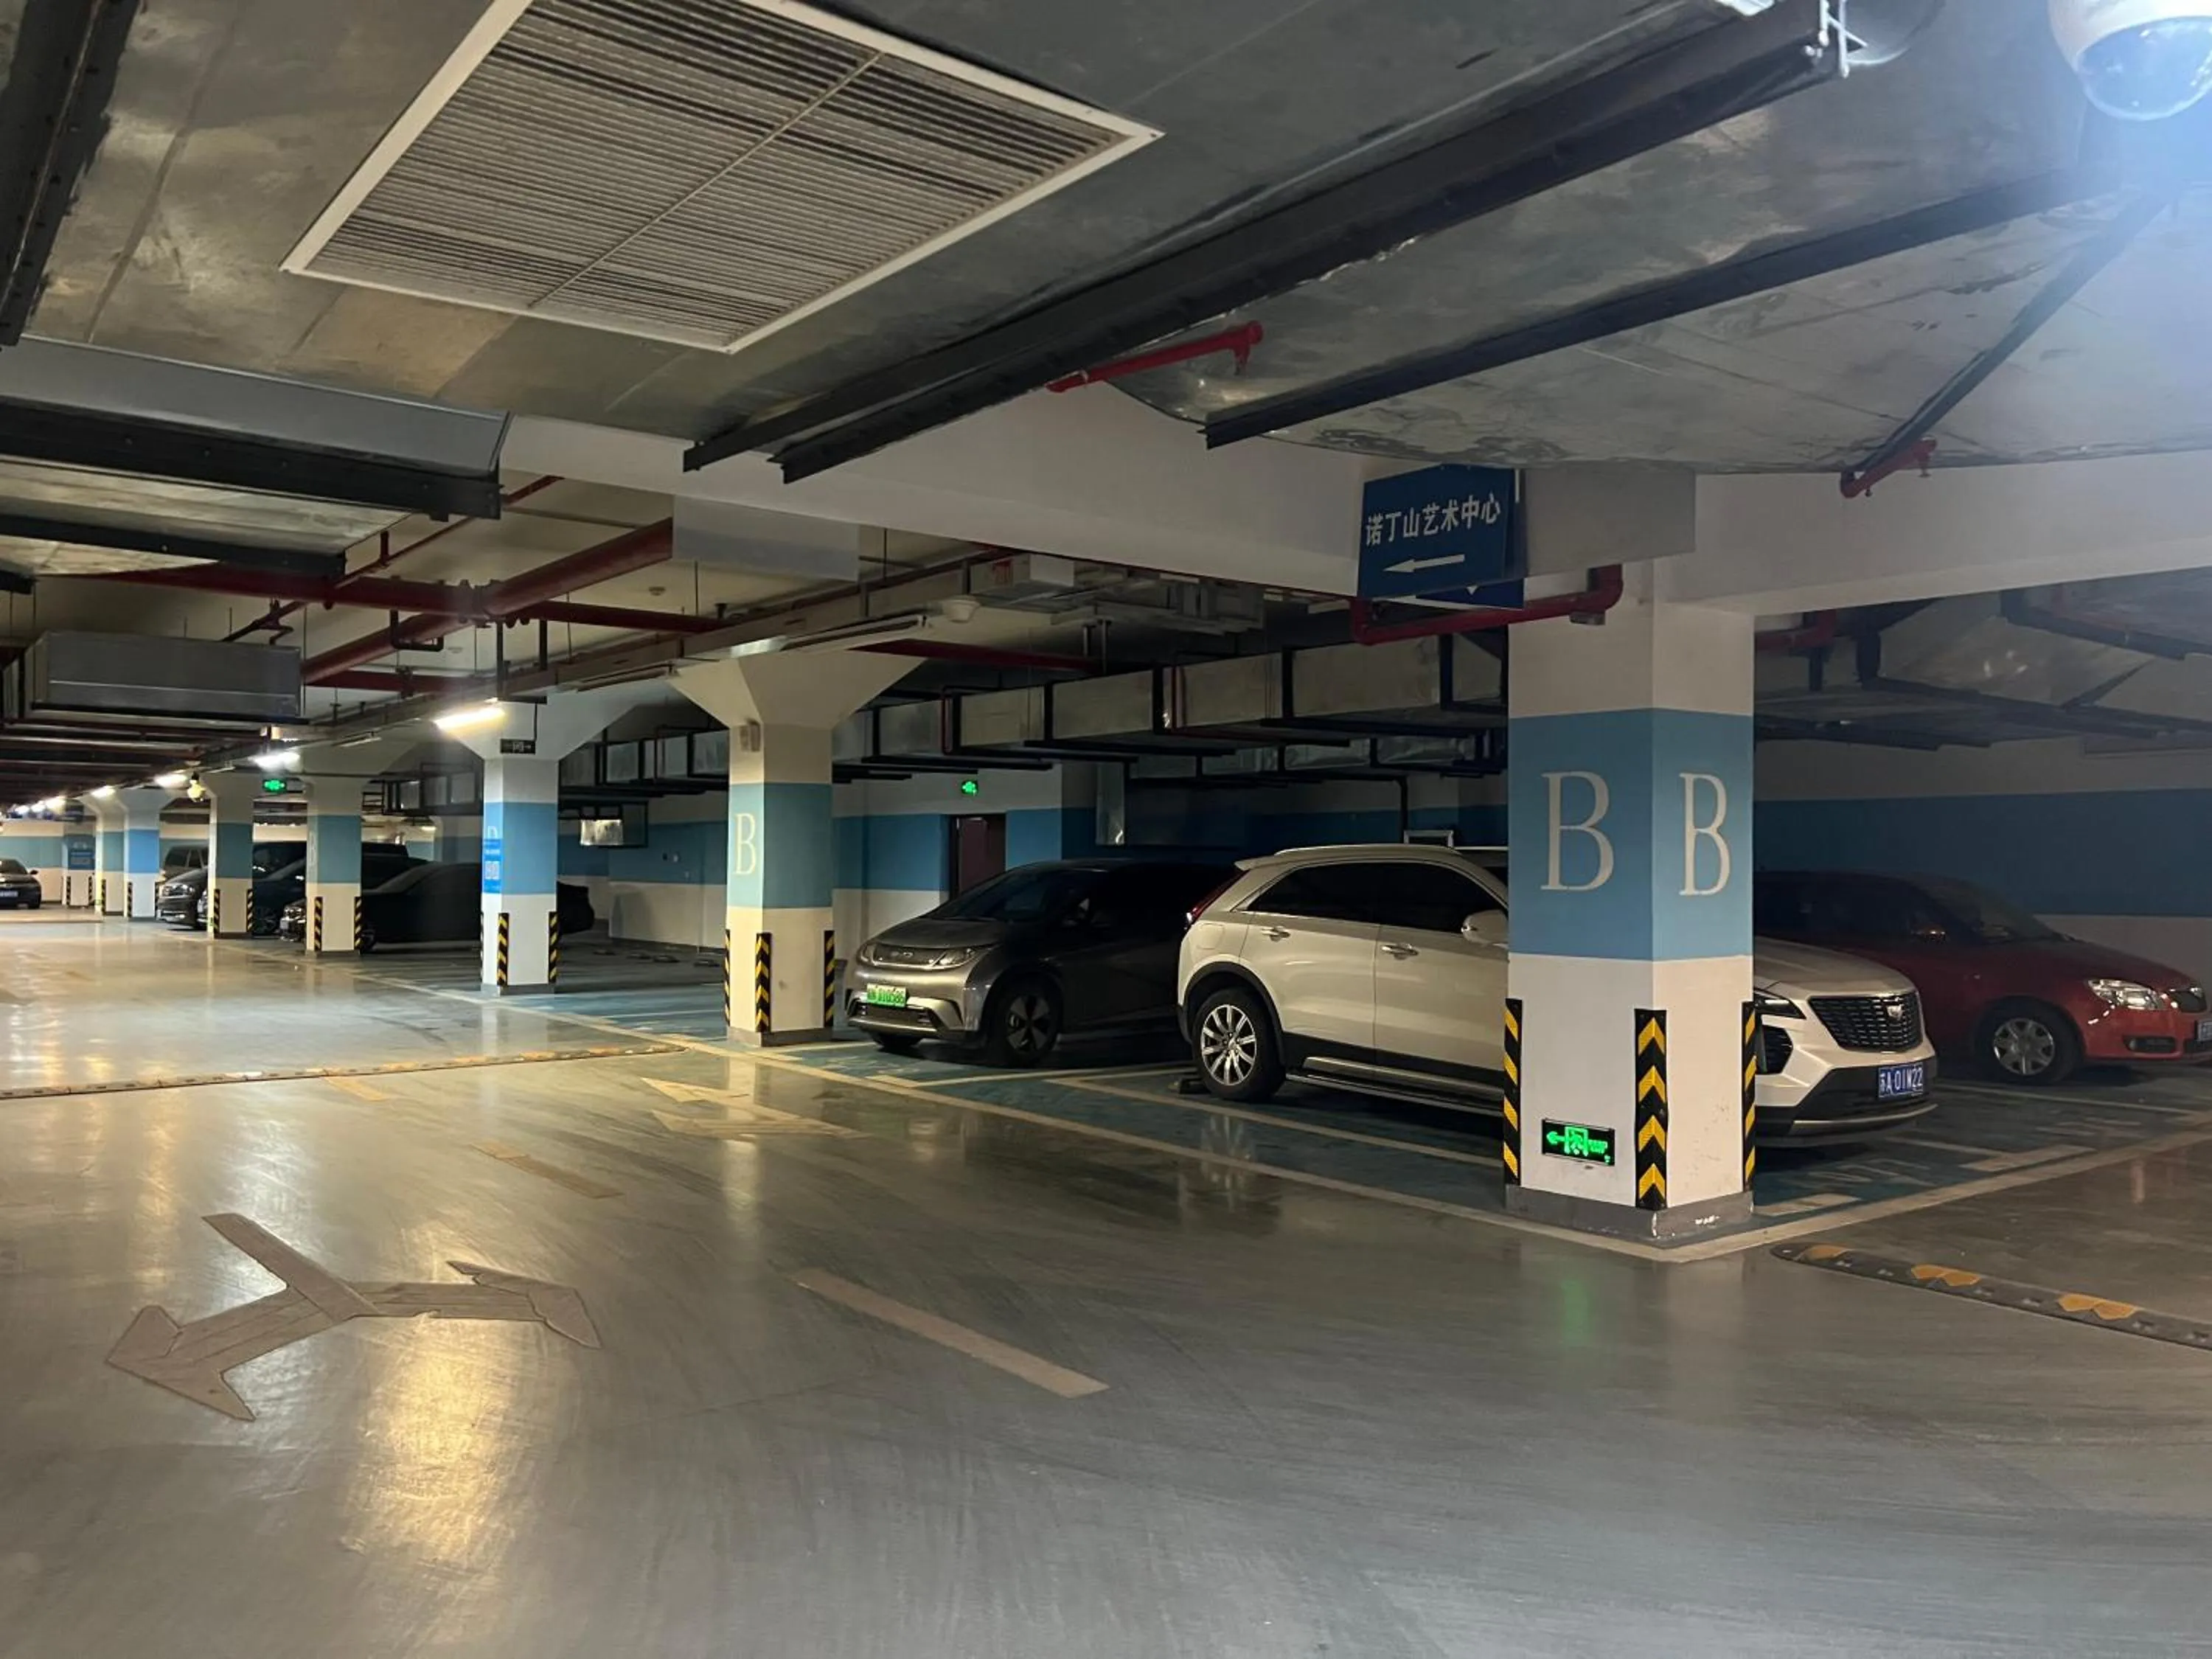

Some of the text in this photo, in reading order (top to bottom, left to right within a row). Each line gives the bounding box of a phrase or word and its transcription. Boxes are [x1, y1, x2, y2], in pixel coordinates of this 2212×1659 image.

[1366, 492, 1501, 546] 诺丁山艺术中心
[734, 813, 756, 874] B
[1540, 771, 1614, 891] B
[1679, 772, 1731, 896] B
